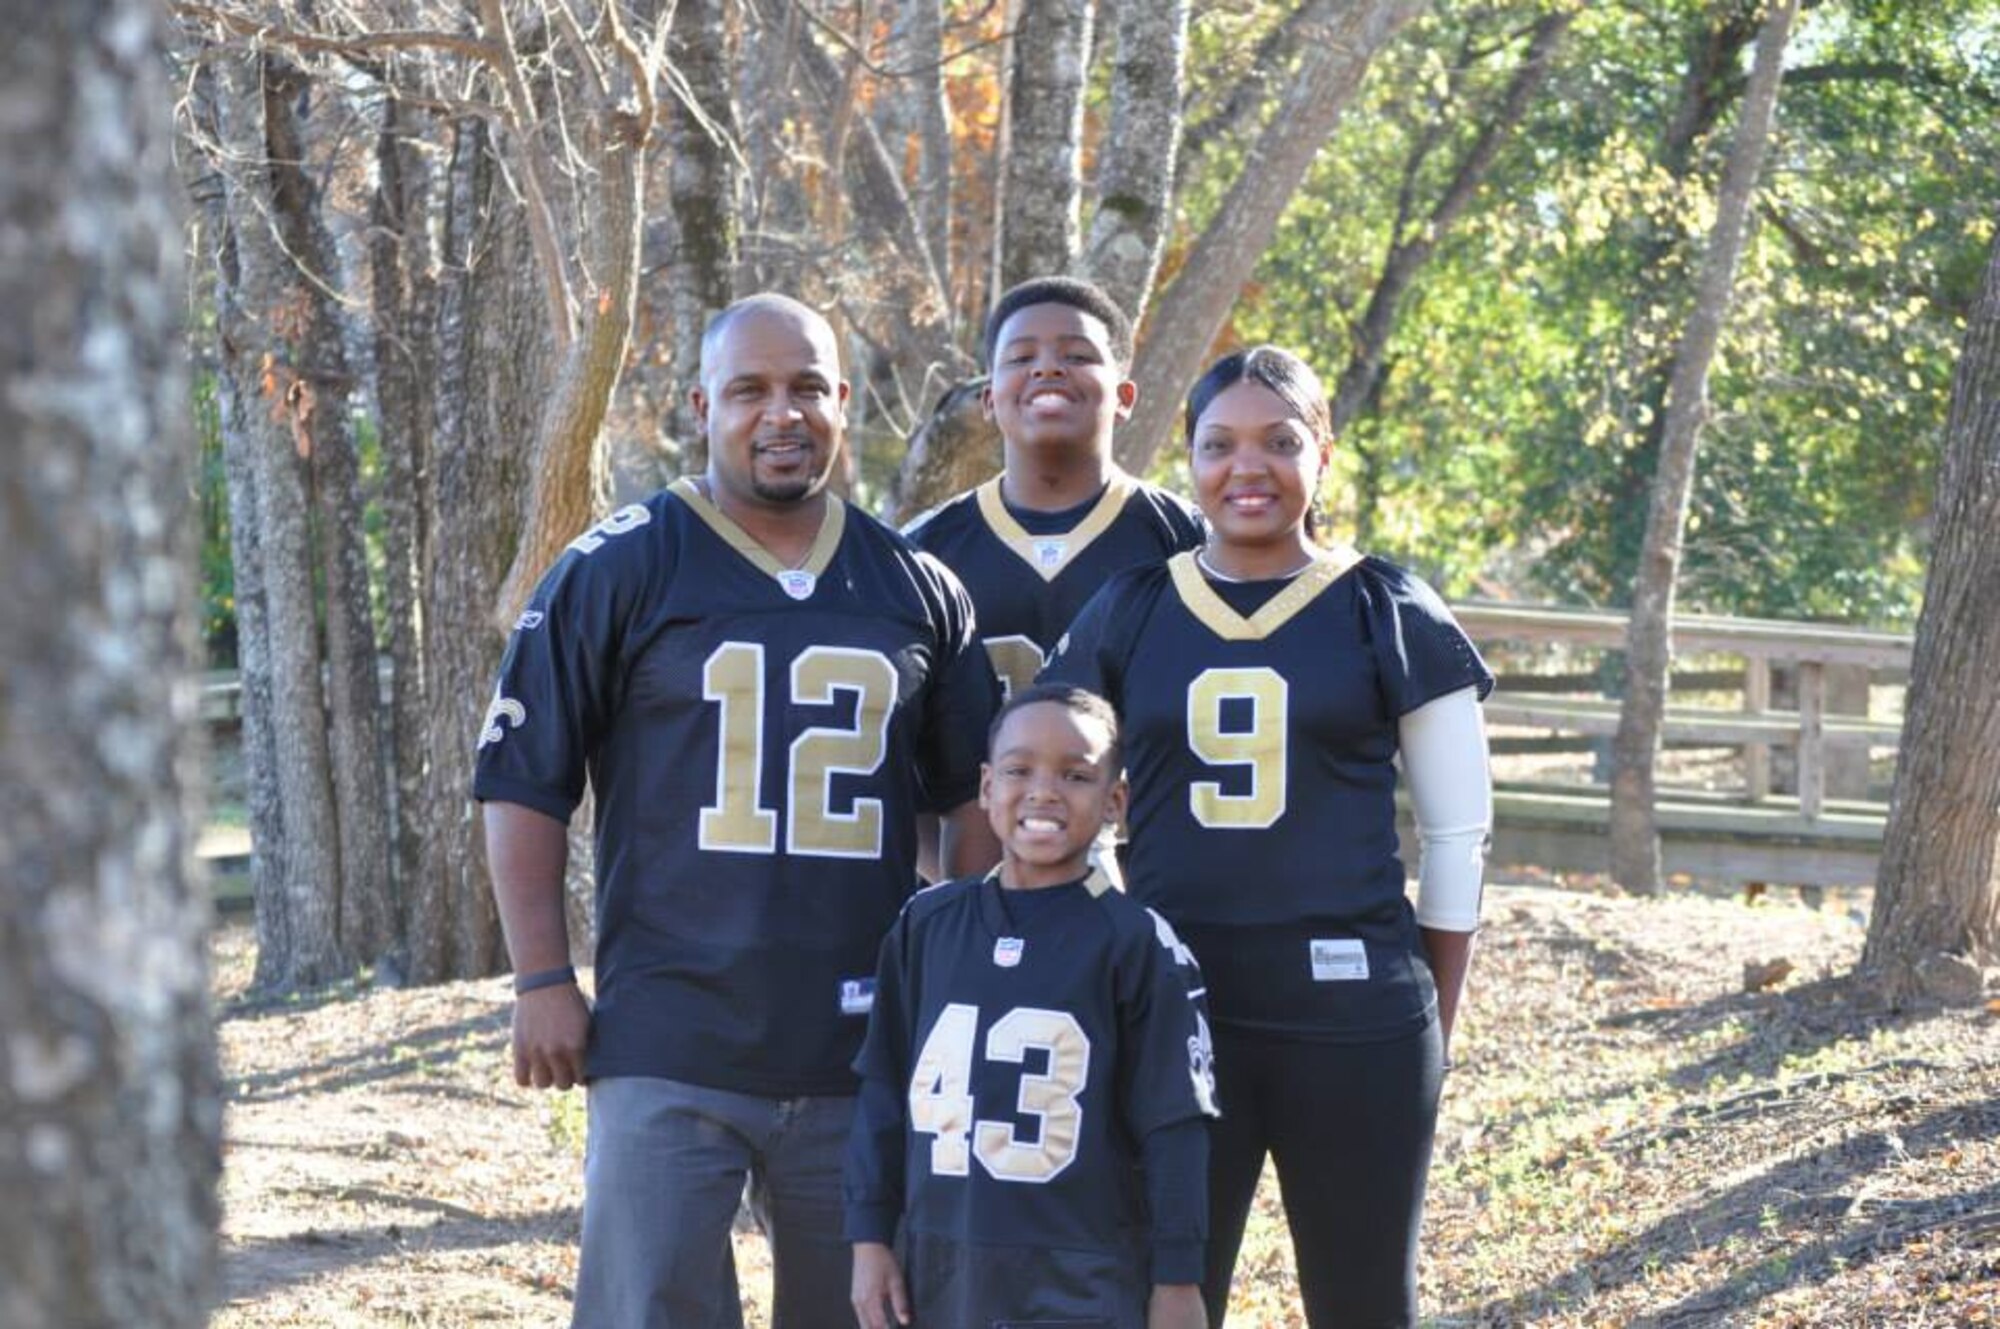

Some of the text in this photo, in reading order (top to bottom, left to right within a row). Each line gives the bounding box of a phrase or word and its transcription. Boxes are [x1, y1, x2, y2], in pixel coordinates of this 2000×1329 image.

[698, 641, 898, 859] 12
[1187, 667, 1289, 829] 9
[909, 1003, 1091, 1183] 43
